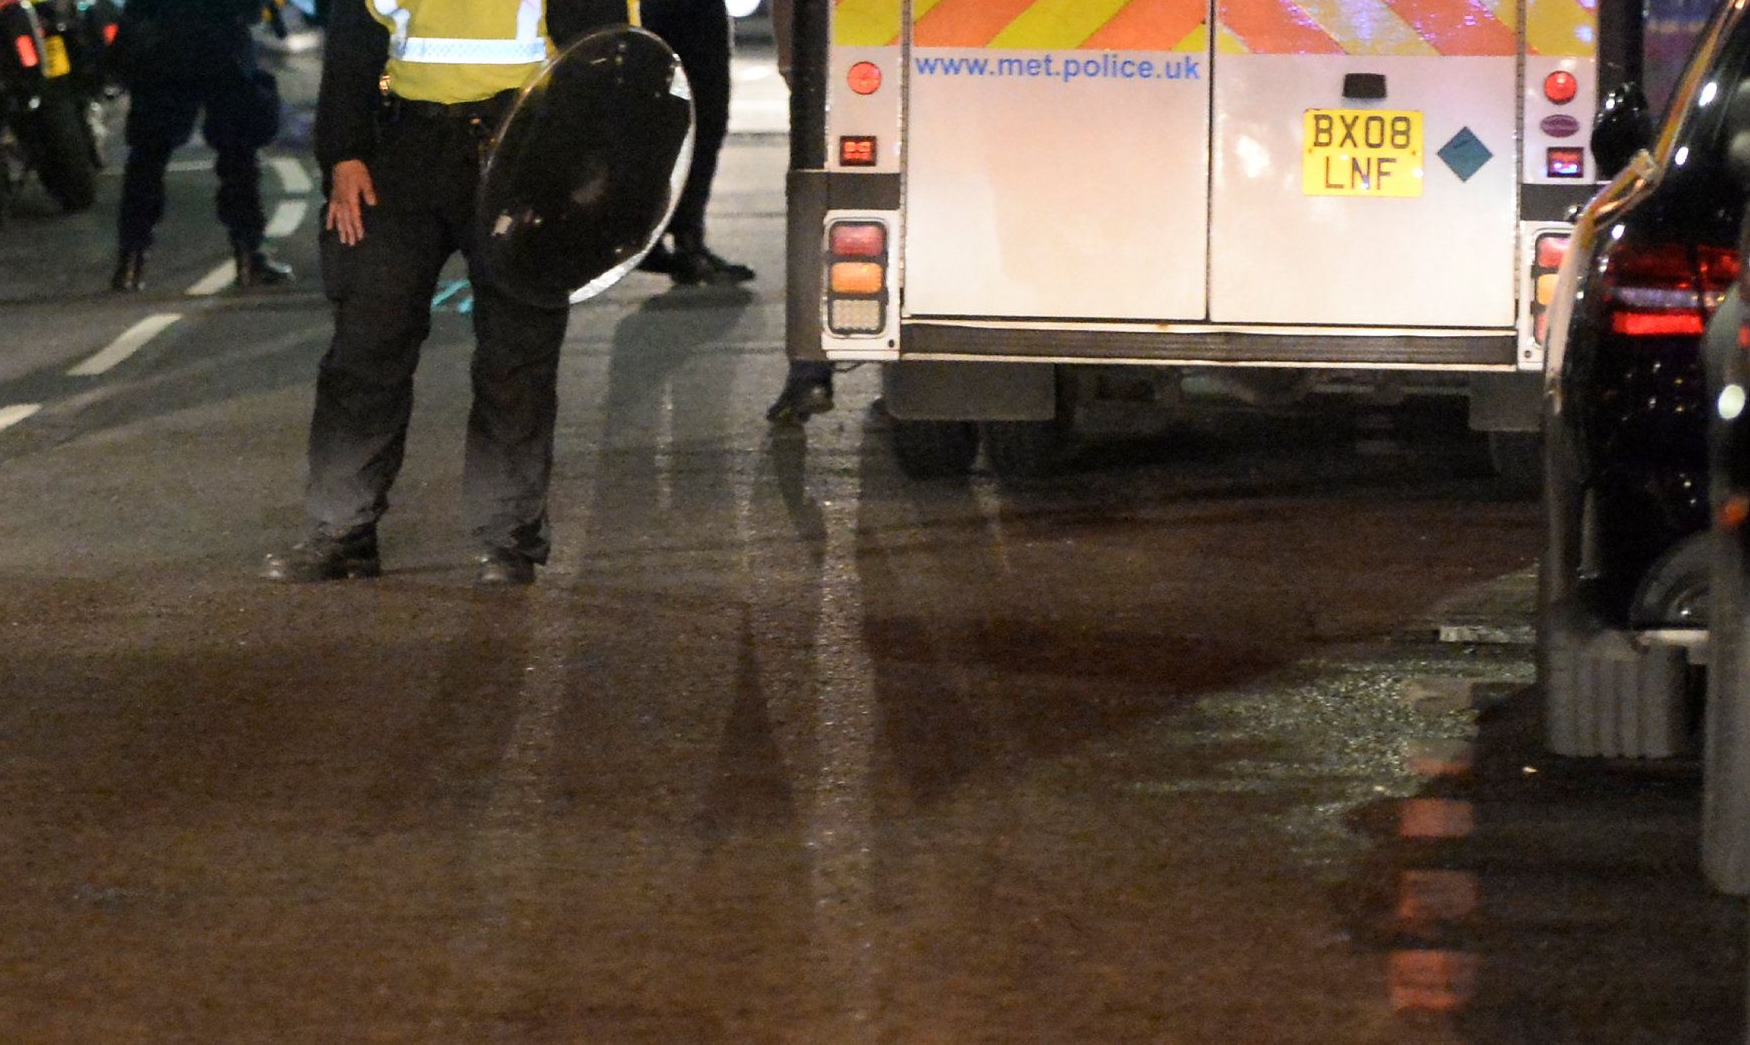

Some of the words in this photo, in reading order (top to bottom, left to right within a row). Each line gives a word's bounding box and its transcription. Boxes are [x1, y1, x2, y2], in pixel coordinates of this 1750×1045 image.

[914, 53, 1201, 83] www.met.police.uk
[1313, 113, 1412, 150] BX08
[1324, 156, 1398, 190] LNF
